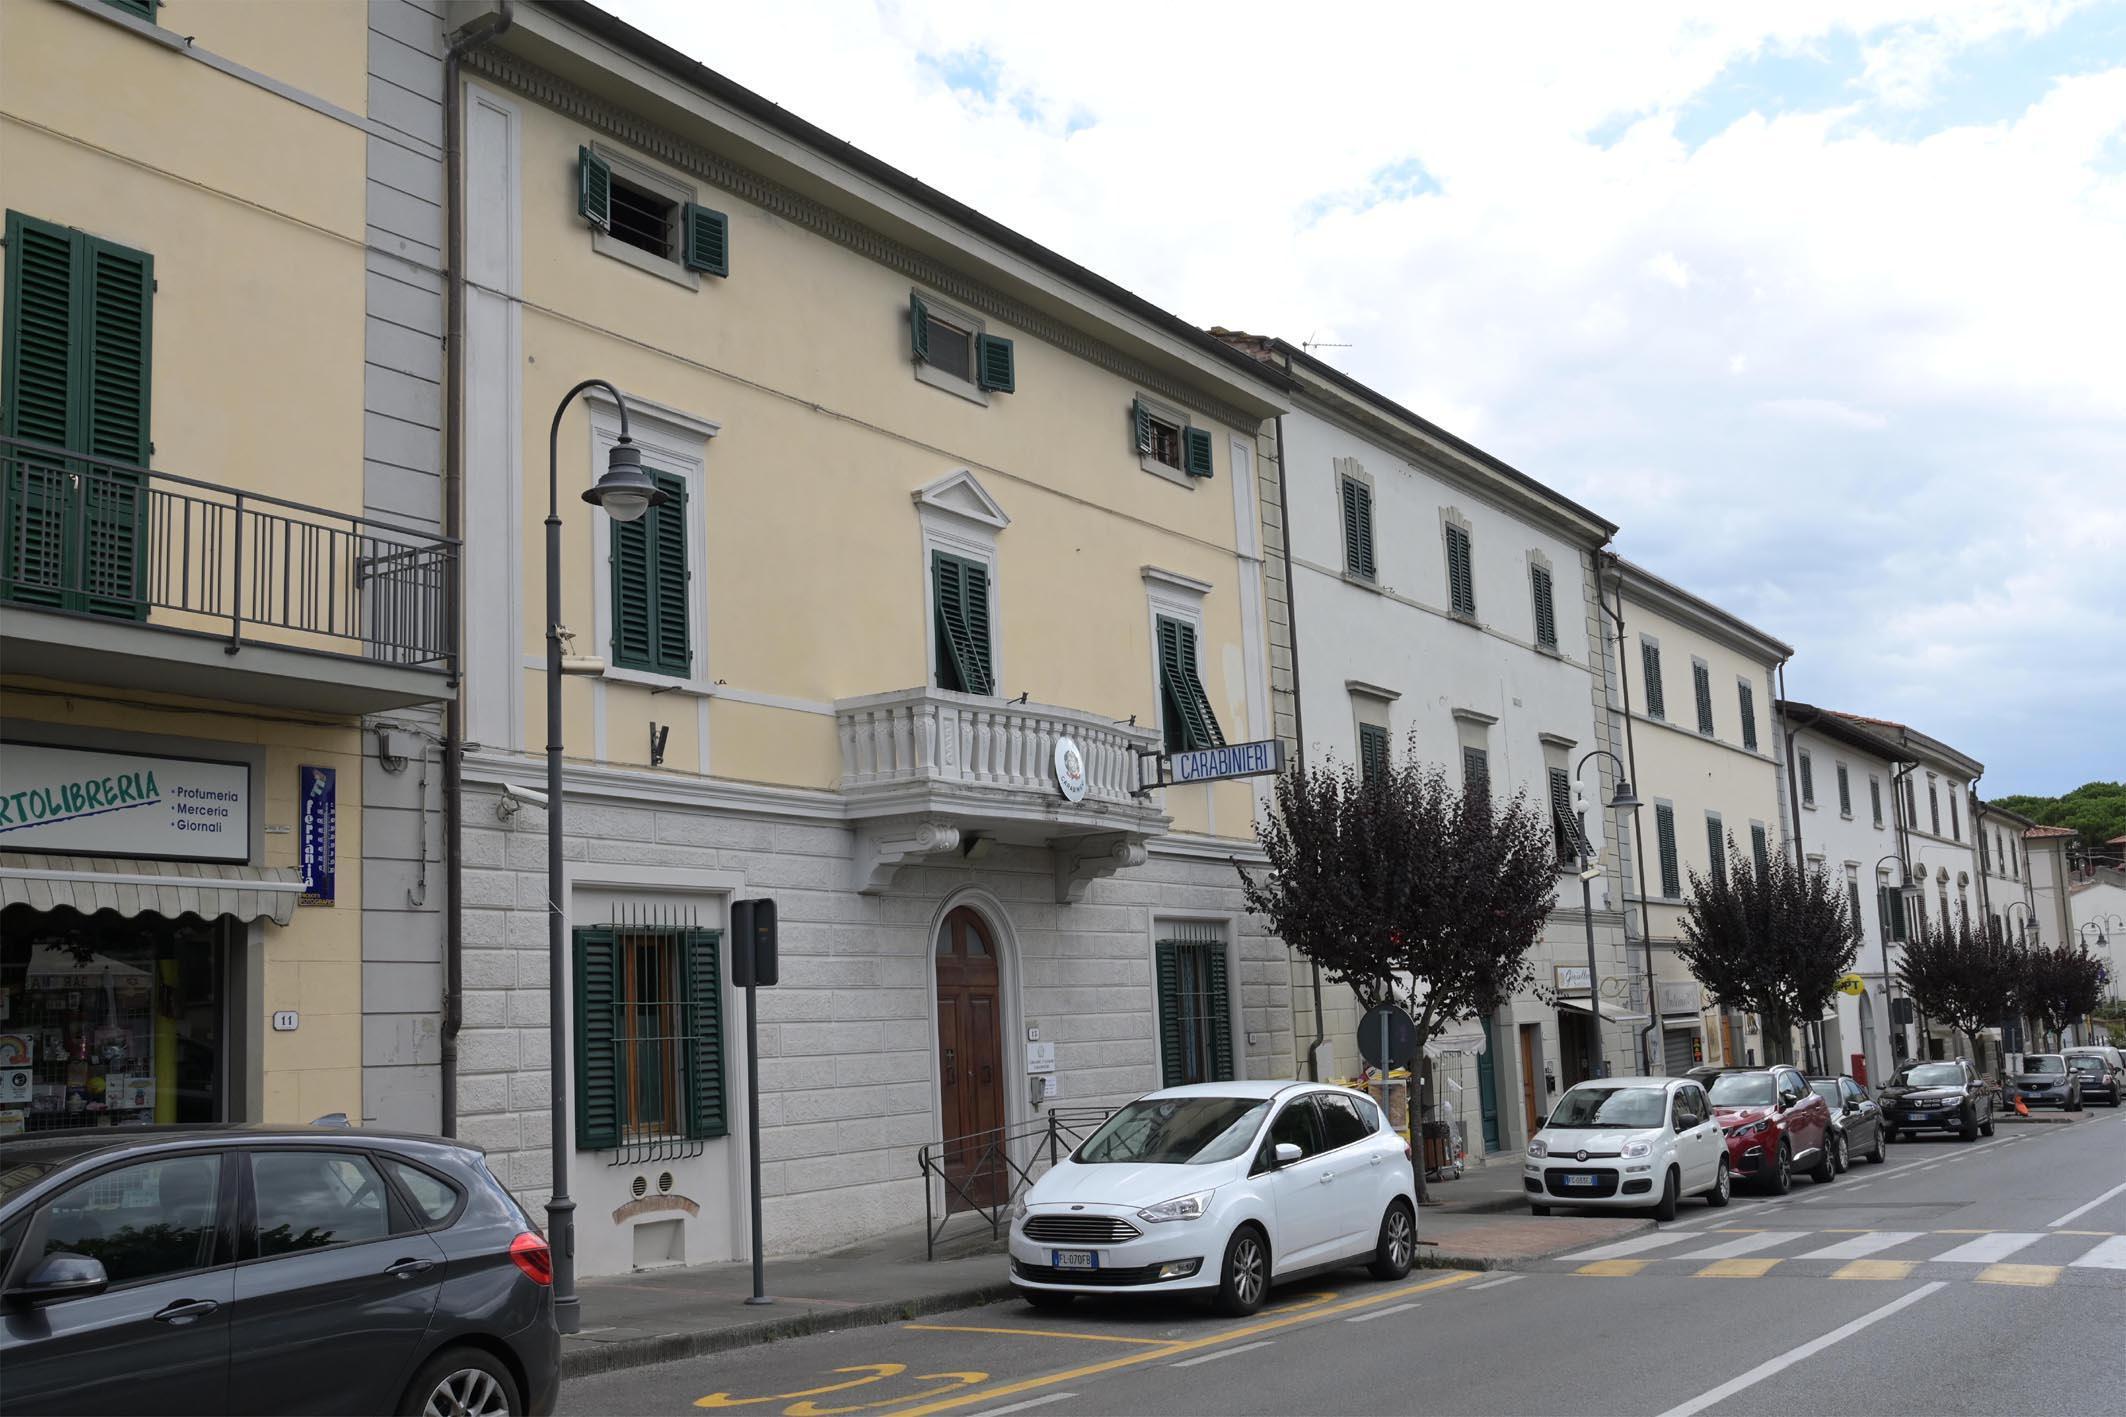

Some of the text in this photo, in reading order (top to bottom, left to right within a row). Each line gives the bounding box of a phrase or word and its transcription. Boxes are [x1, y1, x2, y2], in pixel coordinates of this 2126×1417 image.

[1181, 744, 1268, 779] CARABINIERI
[177, 786, 239, 803] Profumeria
[177, 803, 229, 817] Merceria
[177, 819, 222, 833] Giornali
[281, 1015, 292, 1026] 11
